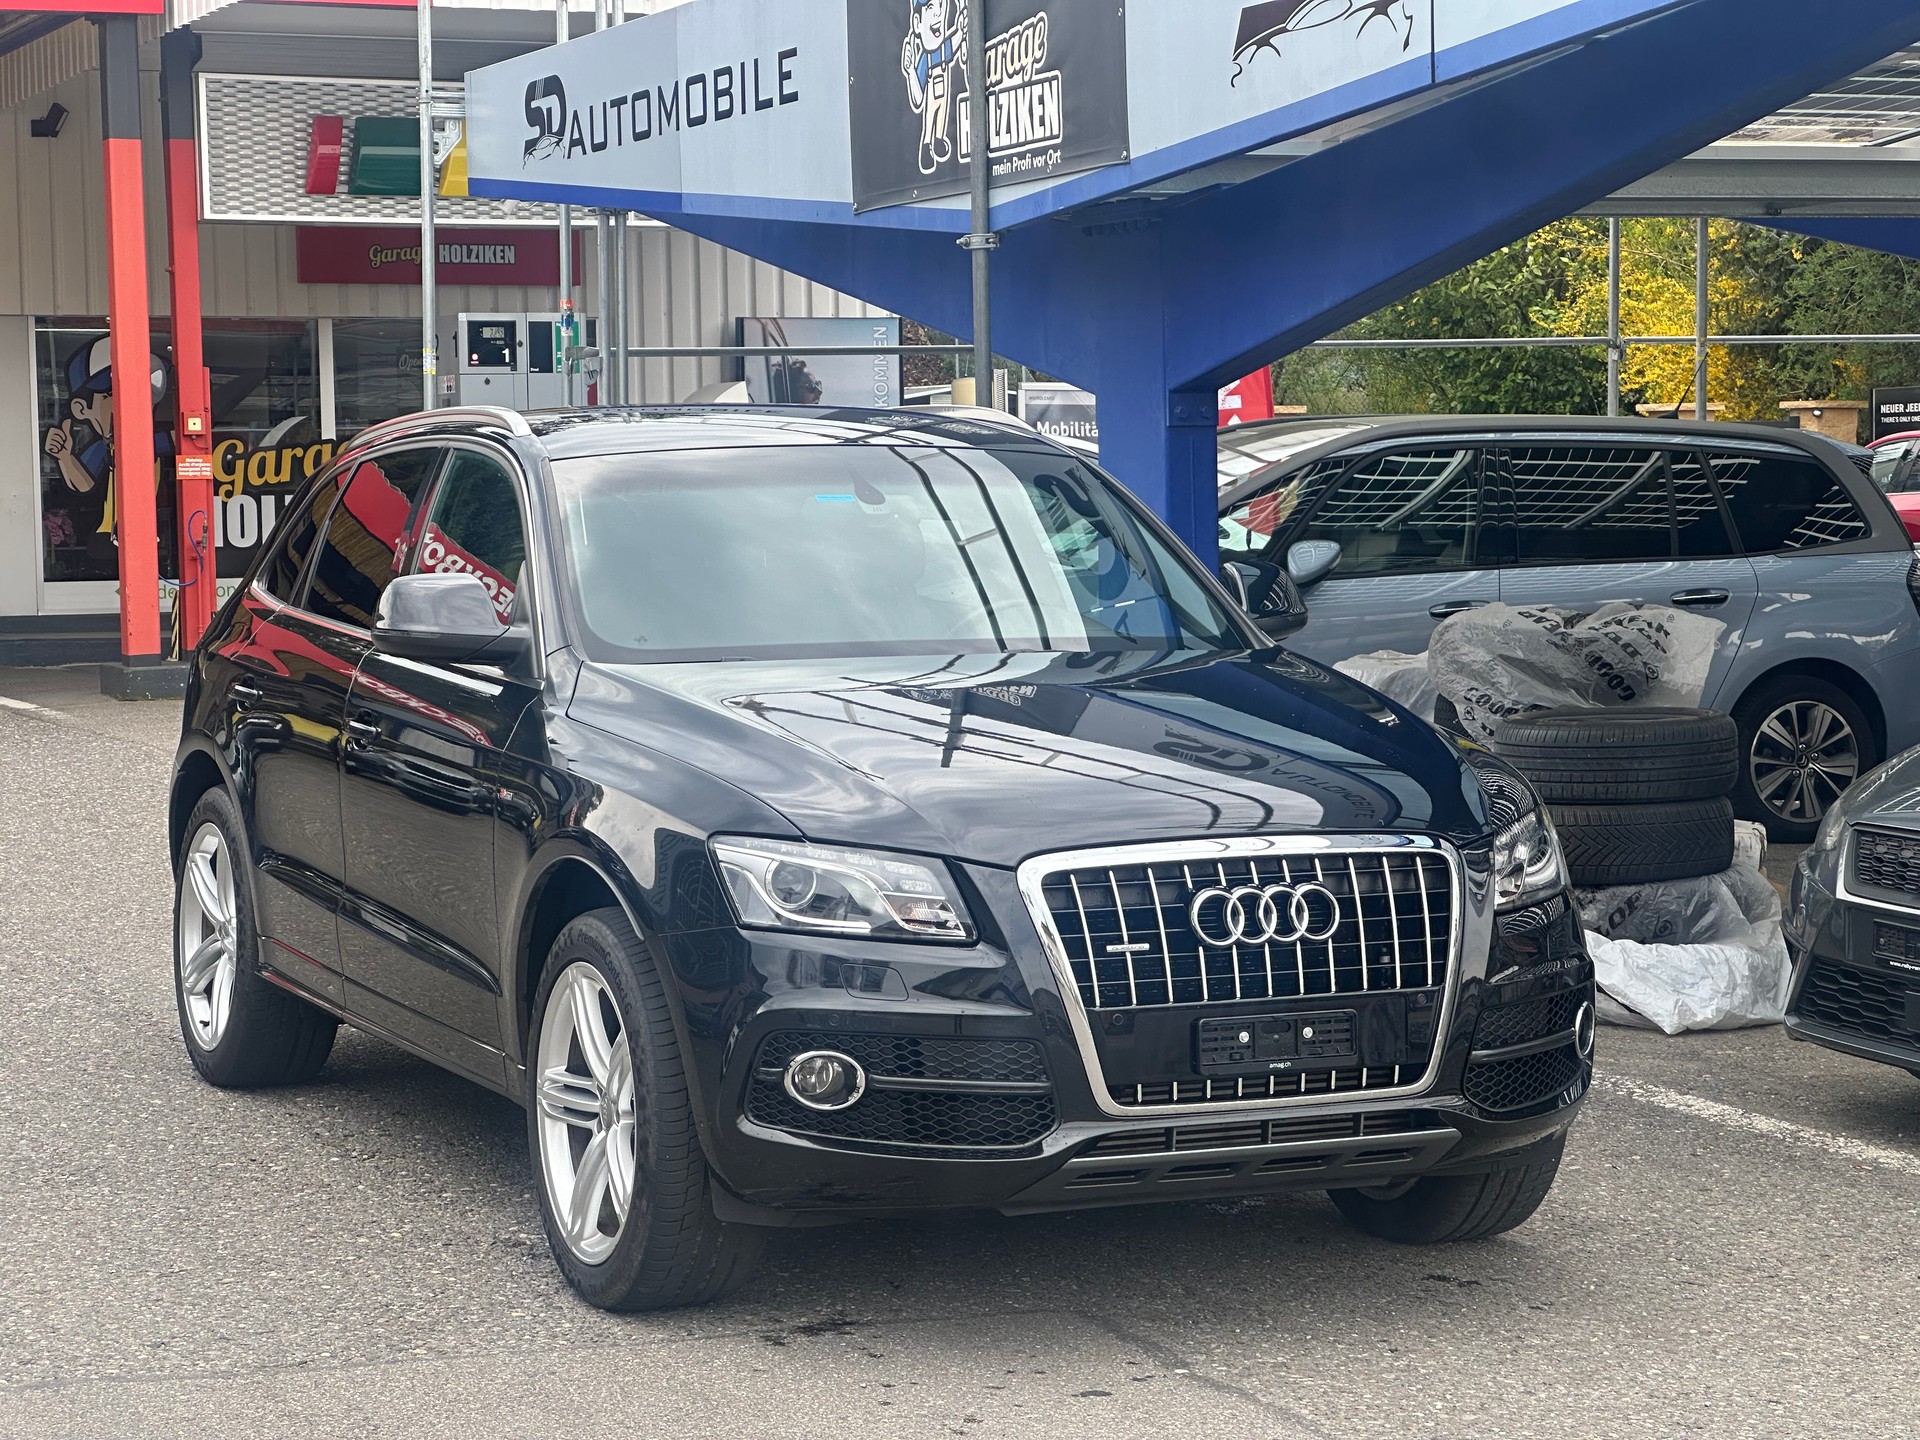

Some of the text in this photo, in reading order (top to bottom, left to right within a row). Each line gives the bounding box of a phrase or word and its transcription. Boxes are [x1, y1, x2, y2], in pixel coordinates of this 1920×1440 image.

[986, 20, 1046, 87] arage
[567, 46, 799, 160] AUTOMOBILE
[959, 79, 1060, 155] HLZIKEN
[992, 149, 1062, 176] mein Profi vor Ort
[369, 244, 516, 268] Garag HOLZIKEN
[1880, 403, 1905, 414] NEUER
[1880, 416, 1899, 424] THERE'S
[212, 438, 352, 502] Gara
[1269, 1061, 1292, 1069] amag.ch
